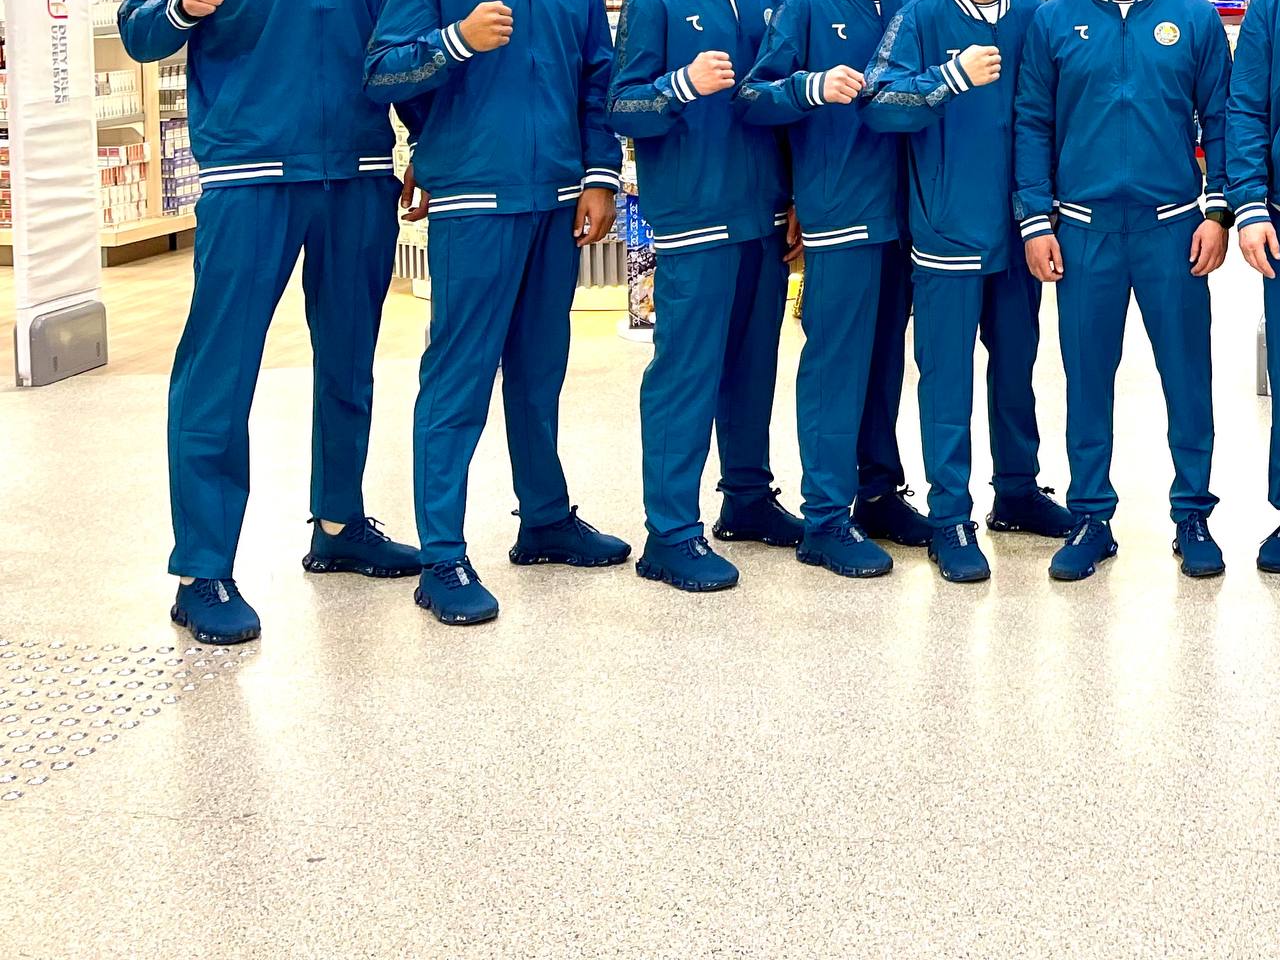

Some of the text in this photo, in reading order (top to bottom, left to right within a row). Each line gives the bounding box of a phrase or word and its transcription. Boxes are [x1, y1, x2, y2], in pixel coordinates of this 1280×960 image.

[51, 24, 62, 104] UZBEKISTAN
[58, 24, 70, 103] DUTY FREE
